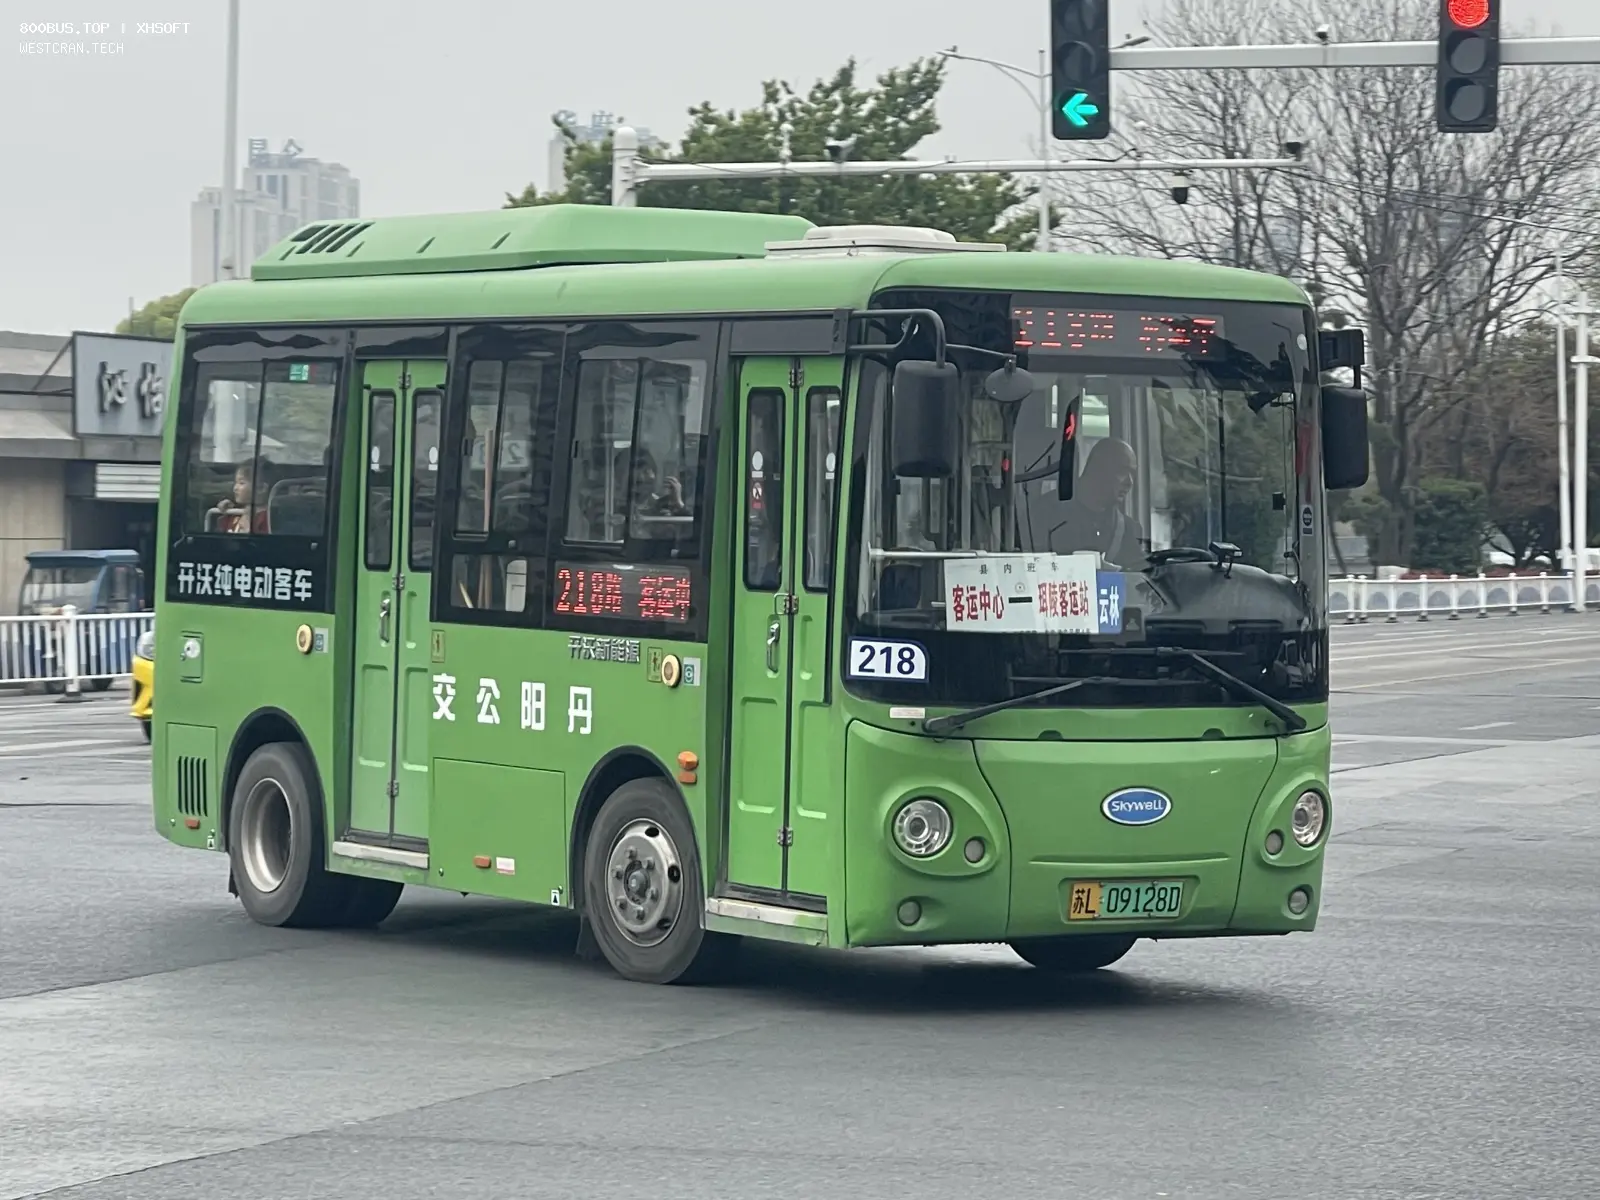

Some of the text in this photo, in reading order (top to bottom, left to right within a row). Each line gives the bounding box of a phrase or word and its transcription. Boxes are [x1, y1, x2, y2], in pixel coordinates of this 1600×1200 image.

[177, 561, 313, 602] 开沃纯电动客车
[979, 561, 1059, 575] 县内班车
[857, 644, 917, 676] 218
[1072, 886, 1181, 915] 苏L 09128D
